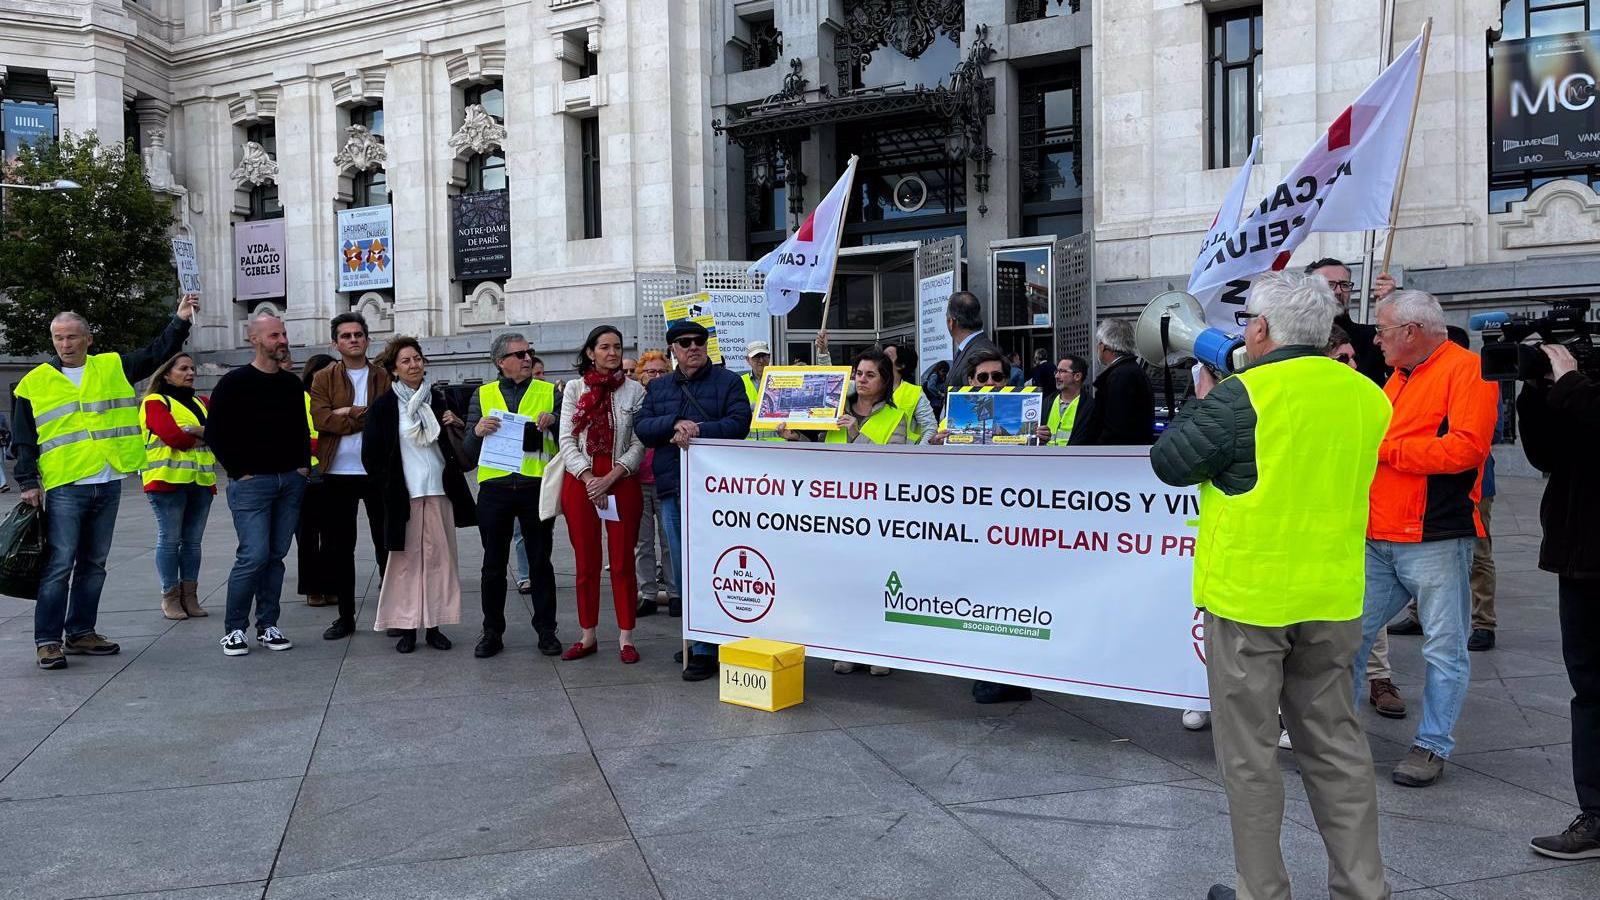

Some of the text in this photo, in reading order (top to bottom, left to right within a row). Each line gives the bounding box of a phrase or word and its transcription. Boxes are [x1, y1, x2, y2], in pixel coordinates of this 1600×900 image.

[459, 225, 507, 236] NOTRE-DAME
[468, 234, 499, 246] DE PARÍS
[247, 243, 269, 254] VIDA
[240, 253, 280, 266] PALACIO
[245, 264, 280, 276] CIBELES
[705, 473, 785, 496] CANTÓN
[792, 480, 804, 497] Y
[809, 480, 878, 501] SELUR
[885, 483, 954, 504] LEJOS
[962, 486, 993, 506] DE
[1000, 487, 1131, 513] COLEGIOS
[1139, 493, 1156, 513] Y
[712, 509, 751, 528] CON
[757, 512, 871, 536] CONSENSO
[878, 519, 979, 543] VECINAL.
[986, 525, 1108, 552] CUMPLAN
[1117, 532, 1152, 555] SU
[712, 577, 775, 596] CANTÓN
[884, 590, 1053, 626] MonteCarmelo
[962, 622, 1040, 637] asociación vecinal
[726, 669, 767, 691] 14.000
